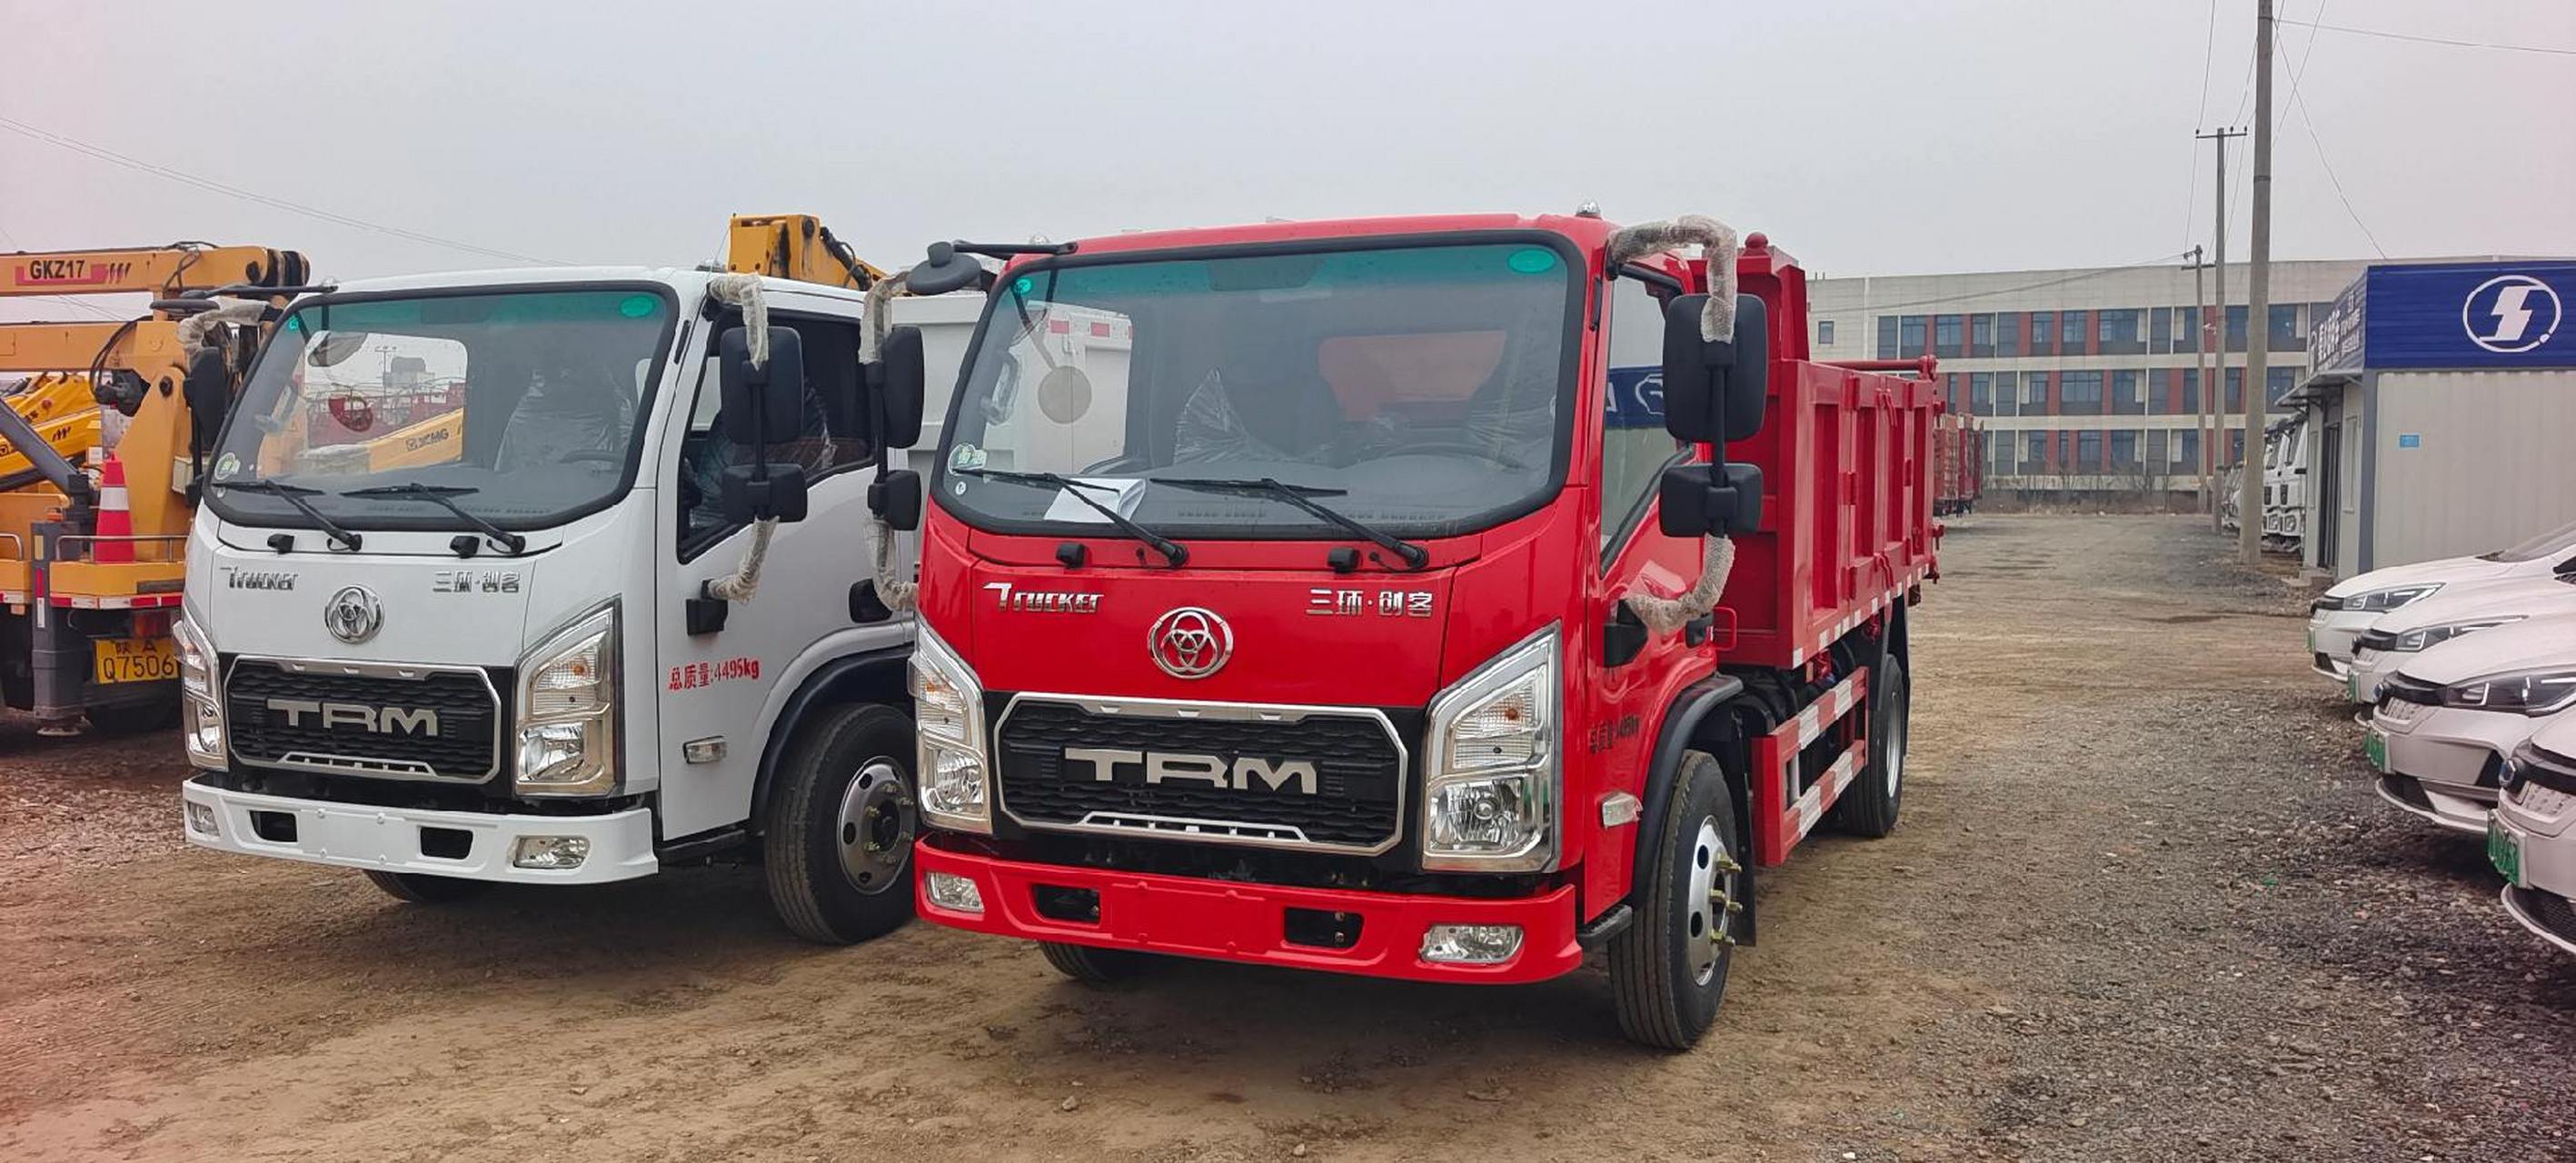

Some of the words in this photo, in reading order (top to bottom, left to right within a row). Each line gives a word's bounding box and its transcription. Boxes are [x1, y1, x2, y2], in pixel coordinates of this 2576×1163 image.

[29, 259, 85, 280] GKZ17
[103, 654, 174, 680] Q7506
[267, 698, 438, 737] TRM
[1065, 747, 1317, 795] TRM
